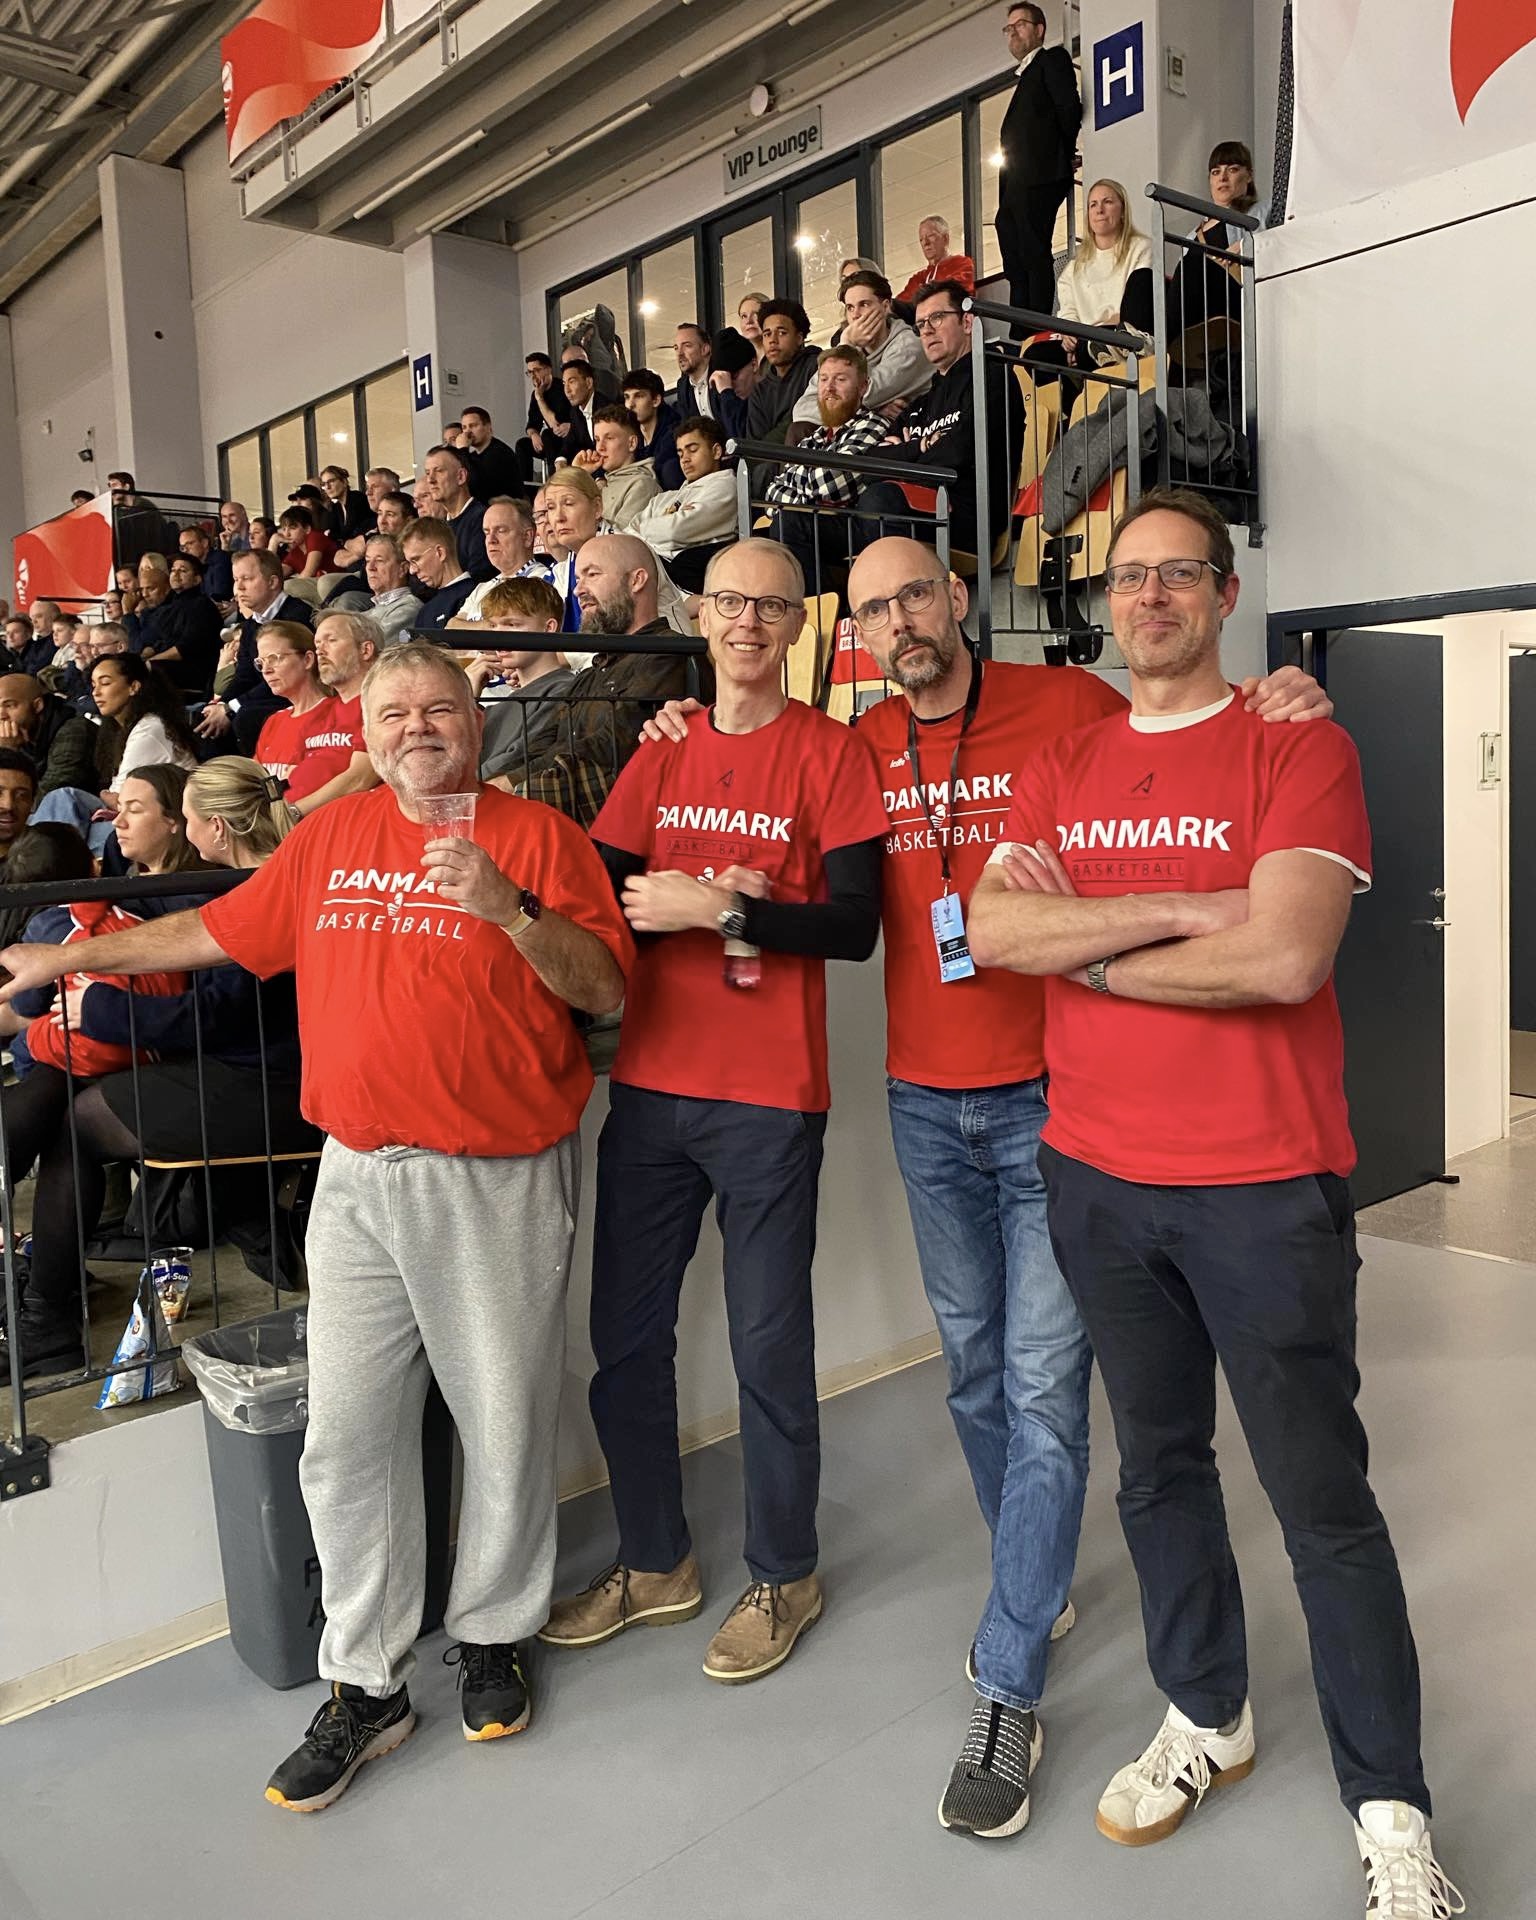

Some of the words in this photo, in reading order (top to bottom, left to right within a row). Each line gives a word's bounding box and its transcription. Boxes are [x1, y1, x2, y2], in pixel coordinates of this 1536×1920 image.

[1102, 46, 1134, 107] H
[728, 152, 754, 180] VIP
[758, 125, 818, 168] Lounge
[416, 366, 430, 399] H
[910, 410, 961, 437] ANMARK
[883, 773, 1013, 813] DANMARK
[328, 869, 449, 893] DANMA
[316, 912, 464, 940] BASKETBALL
